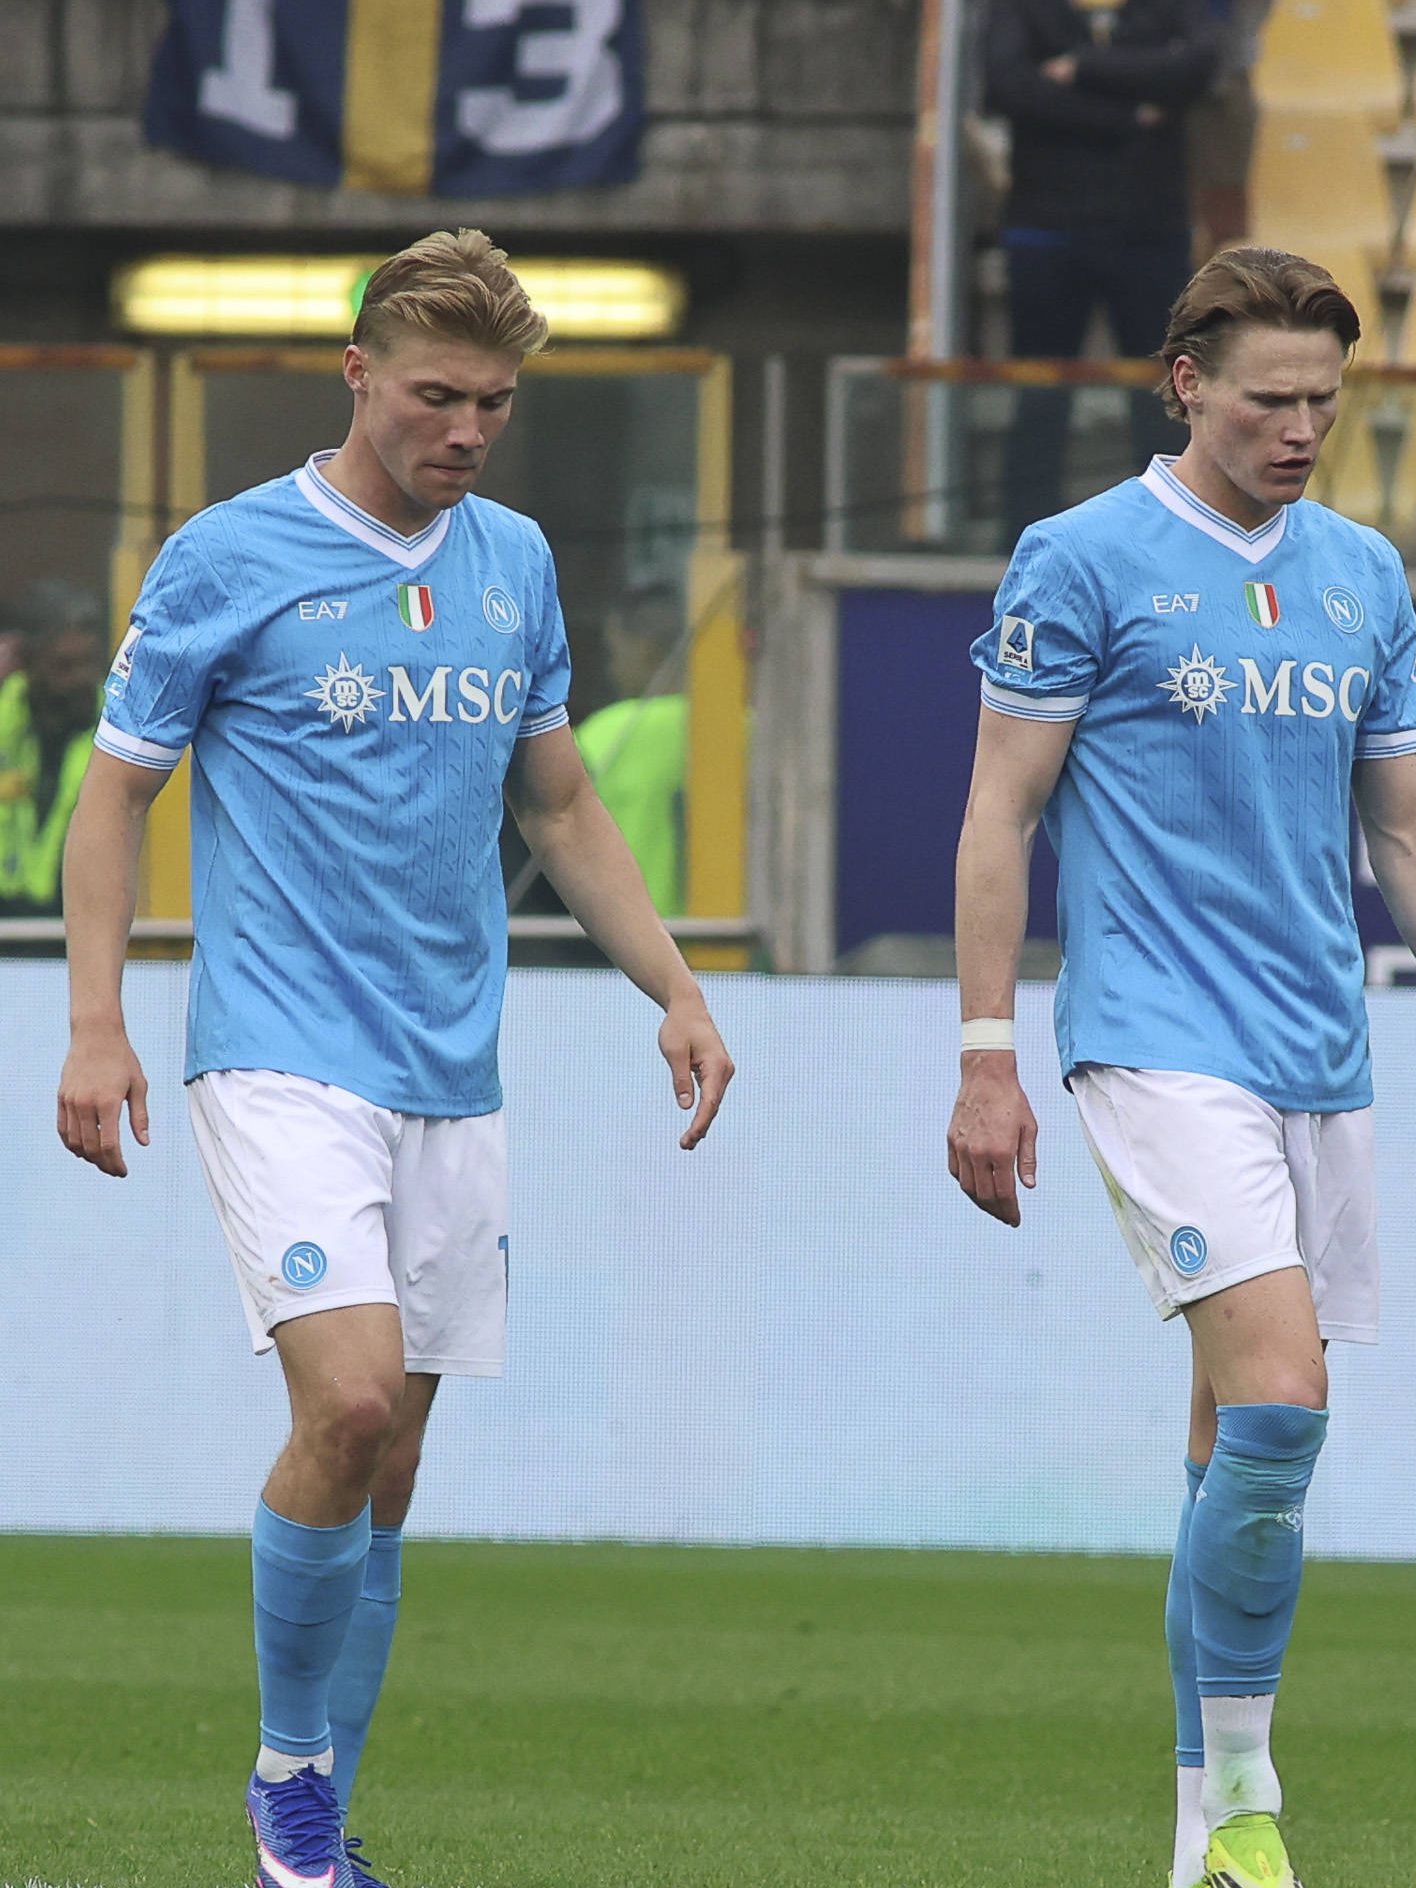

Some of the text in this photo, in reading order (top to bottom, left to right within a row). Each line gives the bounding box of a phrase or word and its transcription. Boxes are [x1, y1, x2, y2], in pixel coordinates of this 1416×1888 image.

[298, 601, 348, 621] EA7
[1152, 593, 1200, 613] EA7
[387, 666, 522, 725] MSC
[1238, 658, 1370, 722] MSC
